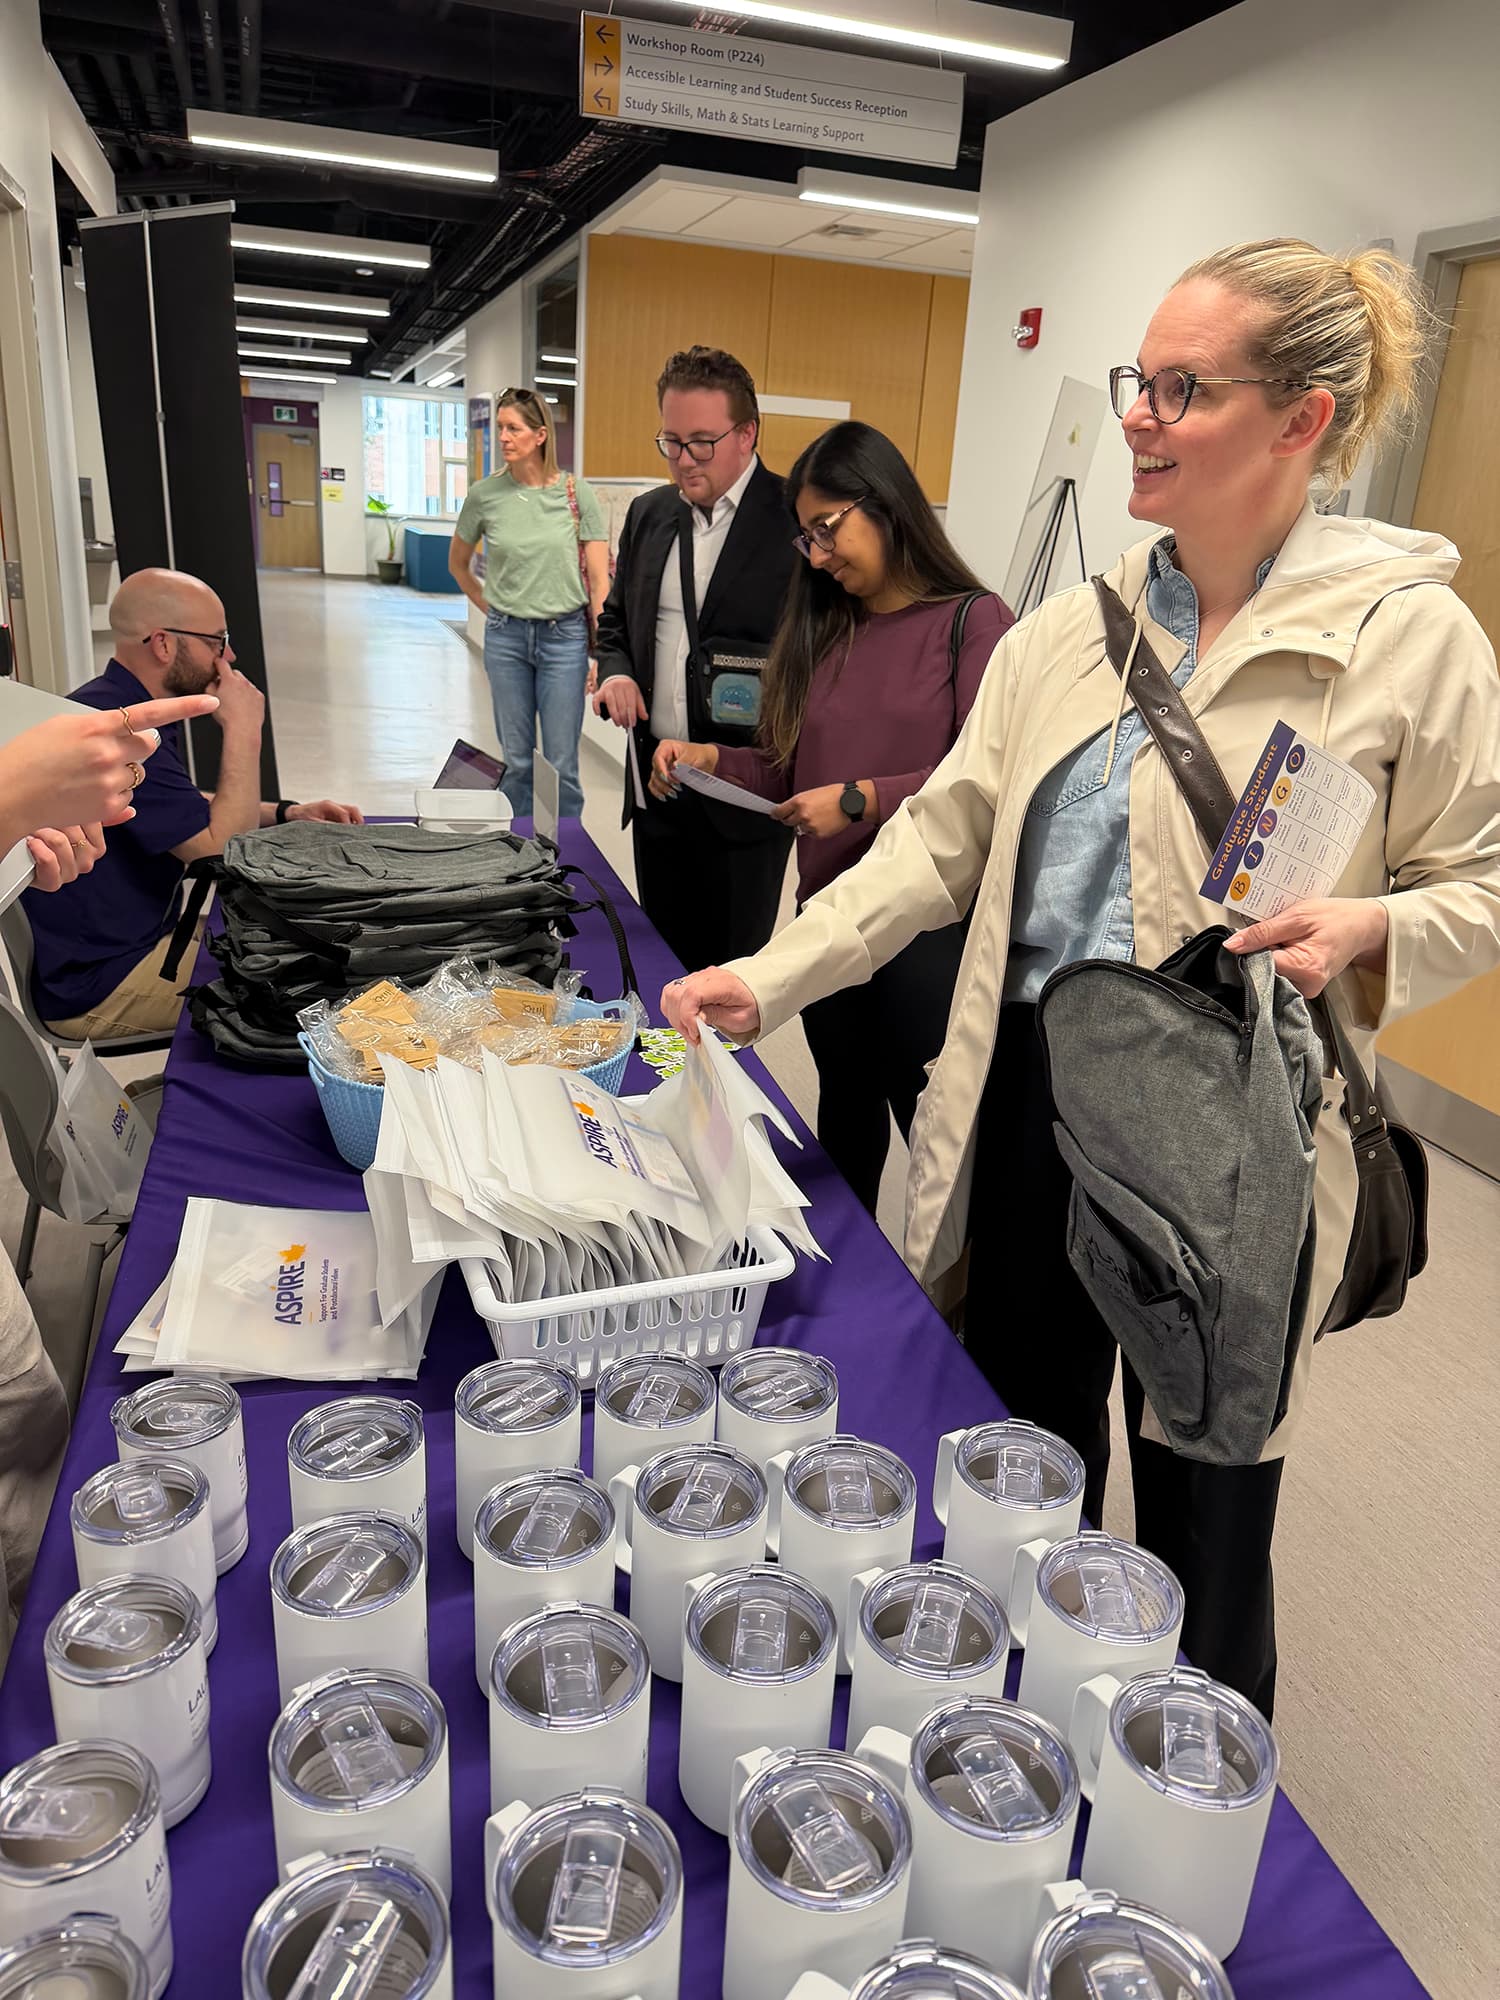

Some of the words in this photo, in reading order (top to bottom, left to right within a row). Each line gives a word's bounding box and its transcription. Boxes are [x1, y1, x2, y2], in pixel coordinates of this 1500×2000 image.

[627, 33, 687, 55] Workshop
[690, 42, 724, 60] Room
[727, 45, 765, 67] (P224)
[625, 66, 686, 85] Accessible
[689, 74, 738, 96] Learning
[741, 81, 761, 97] and
[764, 85, 807, 103] Student
[810, 92, 852, 110] Success
[855, 98, 908, 119] Reception
[625, 97, 658, 116] Study
[661, 101, 693, 120] Skills,
[696, 106, 726, 123] Math
[729, 112, 738, 124] &
[741, 112, 769, 129] Stats
[772, 117, 819, 138] Learning
[822, 124, 865, 142] Support
[1211, 809, 1248, 881] Graduate
[1244, 743, 1278, 805] Student
[1236, 787, 1268, 847] Success
[578, 1113, 618, 1169] ASPIRE
[274, 1261, 306, 1325] ASPIRE
[320, 1275, 328, 1294] Graduate
[319, 1302, 328, 1322] Support
[330, 1310, 338, 1320] and
